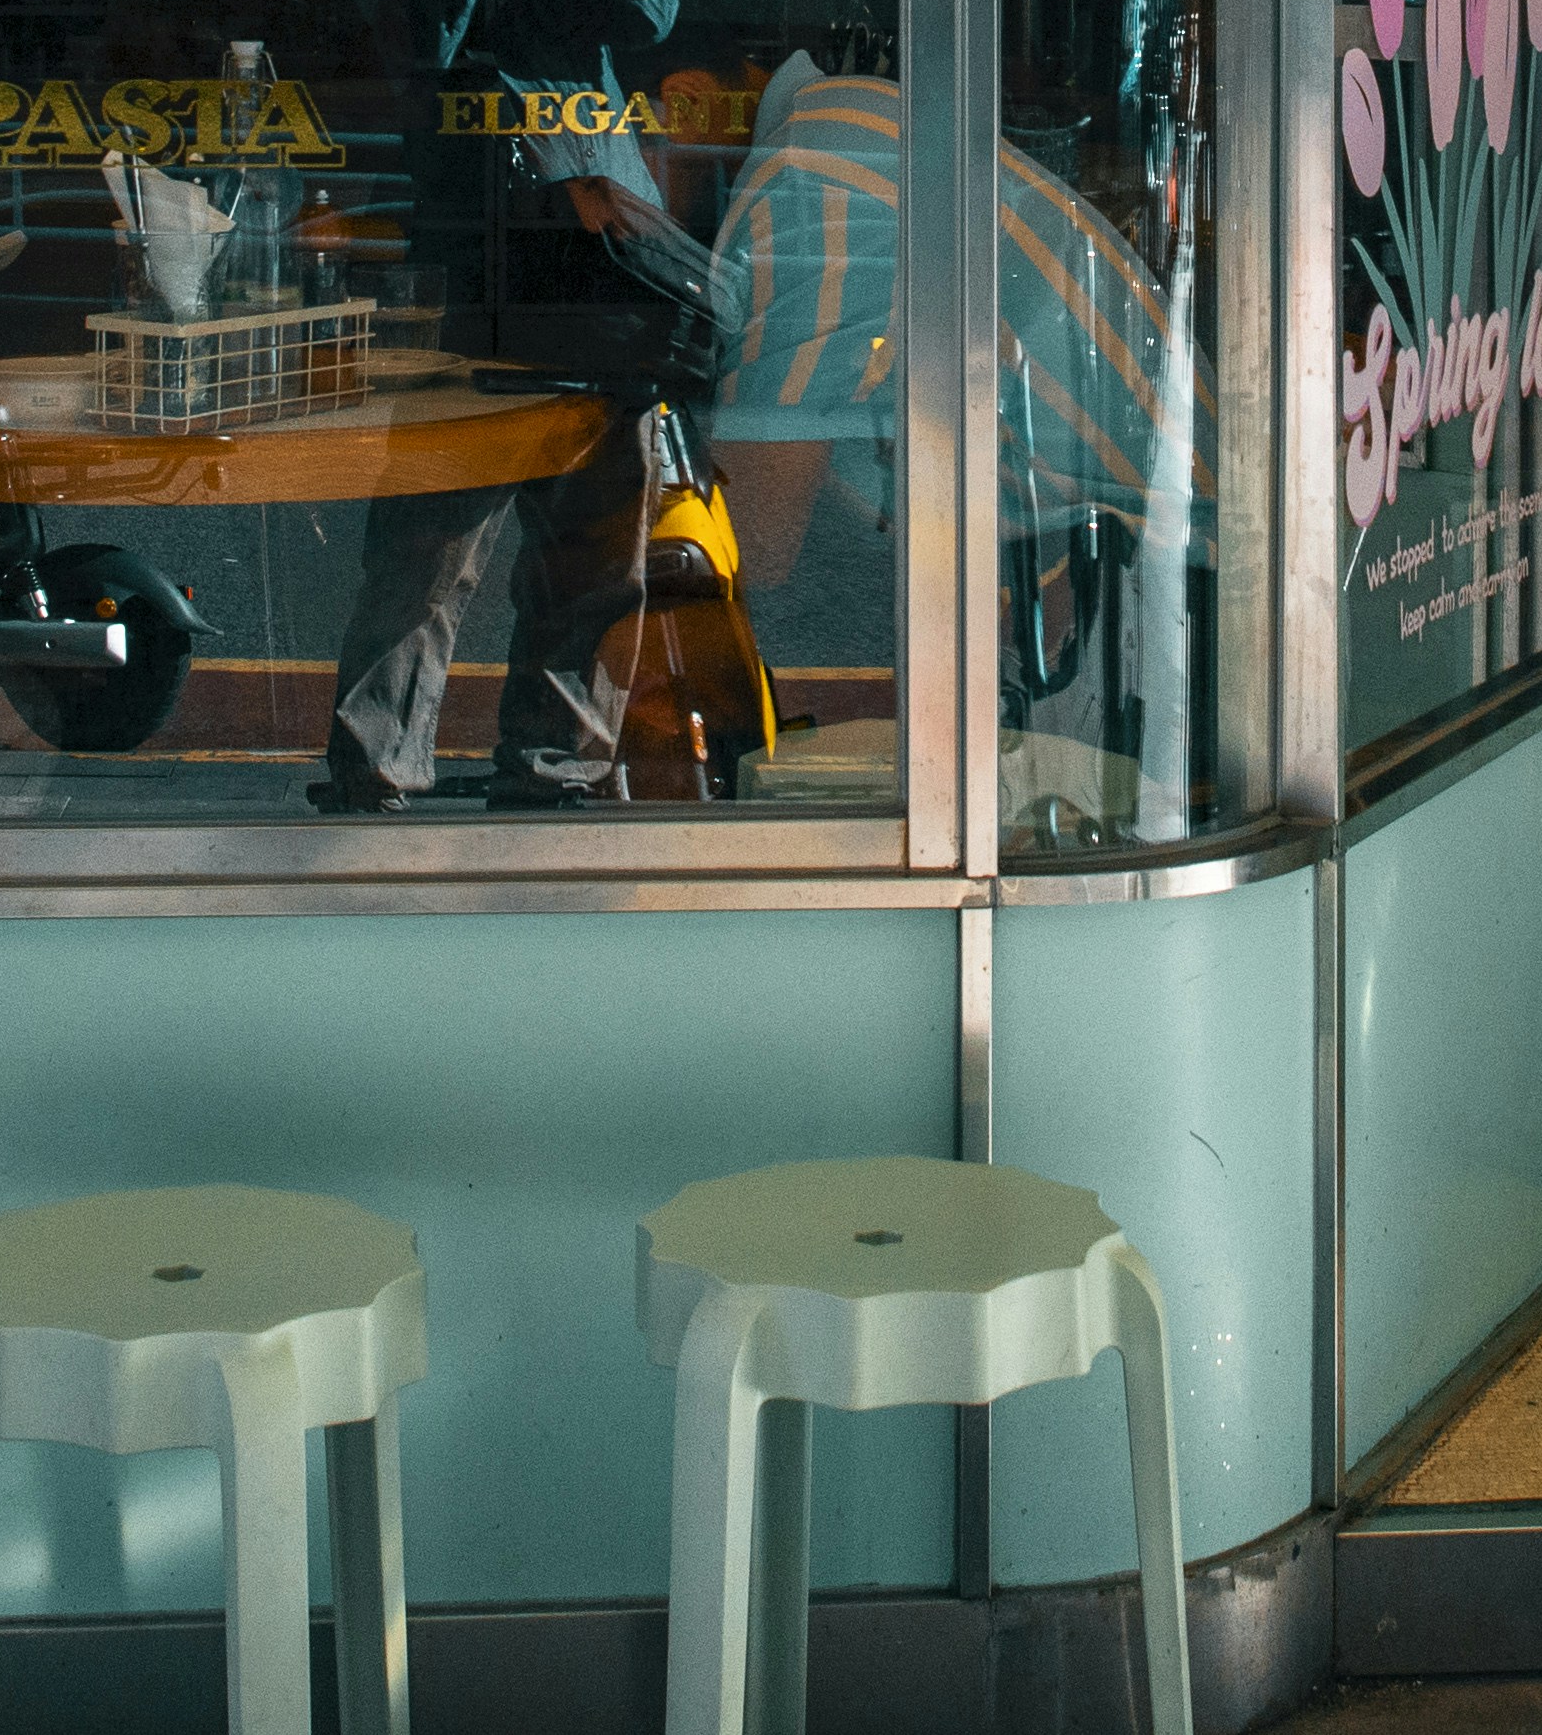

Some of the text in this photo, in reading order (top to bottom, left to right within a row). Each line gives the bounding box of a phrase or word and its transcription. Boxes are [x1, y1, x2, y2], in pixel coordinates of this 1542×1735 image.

[436, 90, 756, 136] ELEGANT
[1344, 293, 1509, 527] Spring
[1366, 556, 1387, 592] We
[1390, 518, 1435, 584] stopped
[1441, 514, 1455, 554] to
[1400, 600, 1426, 643] keep
[1429, 575, 1456, 622] calm
